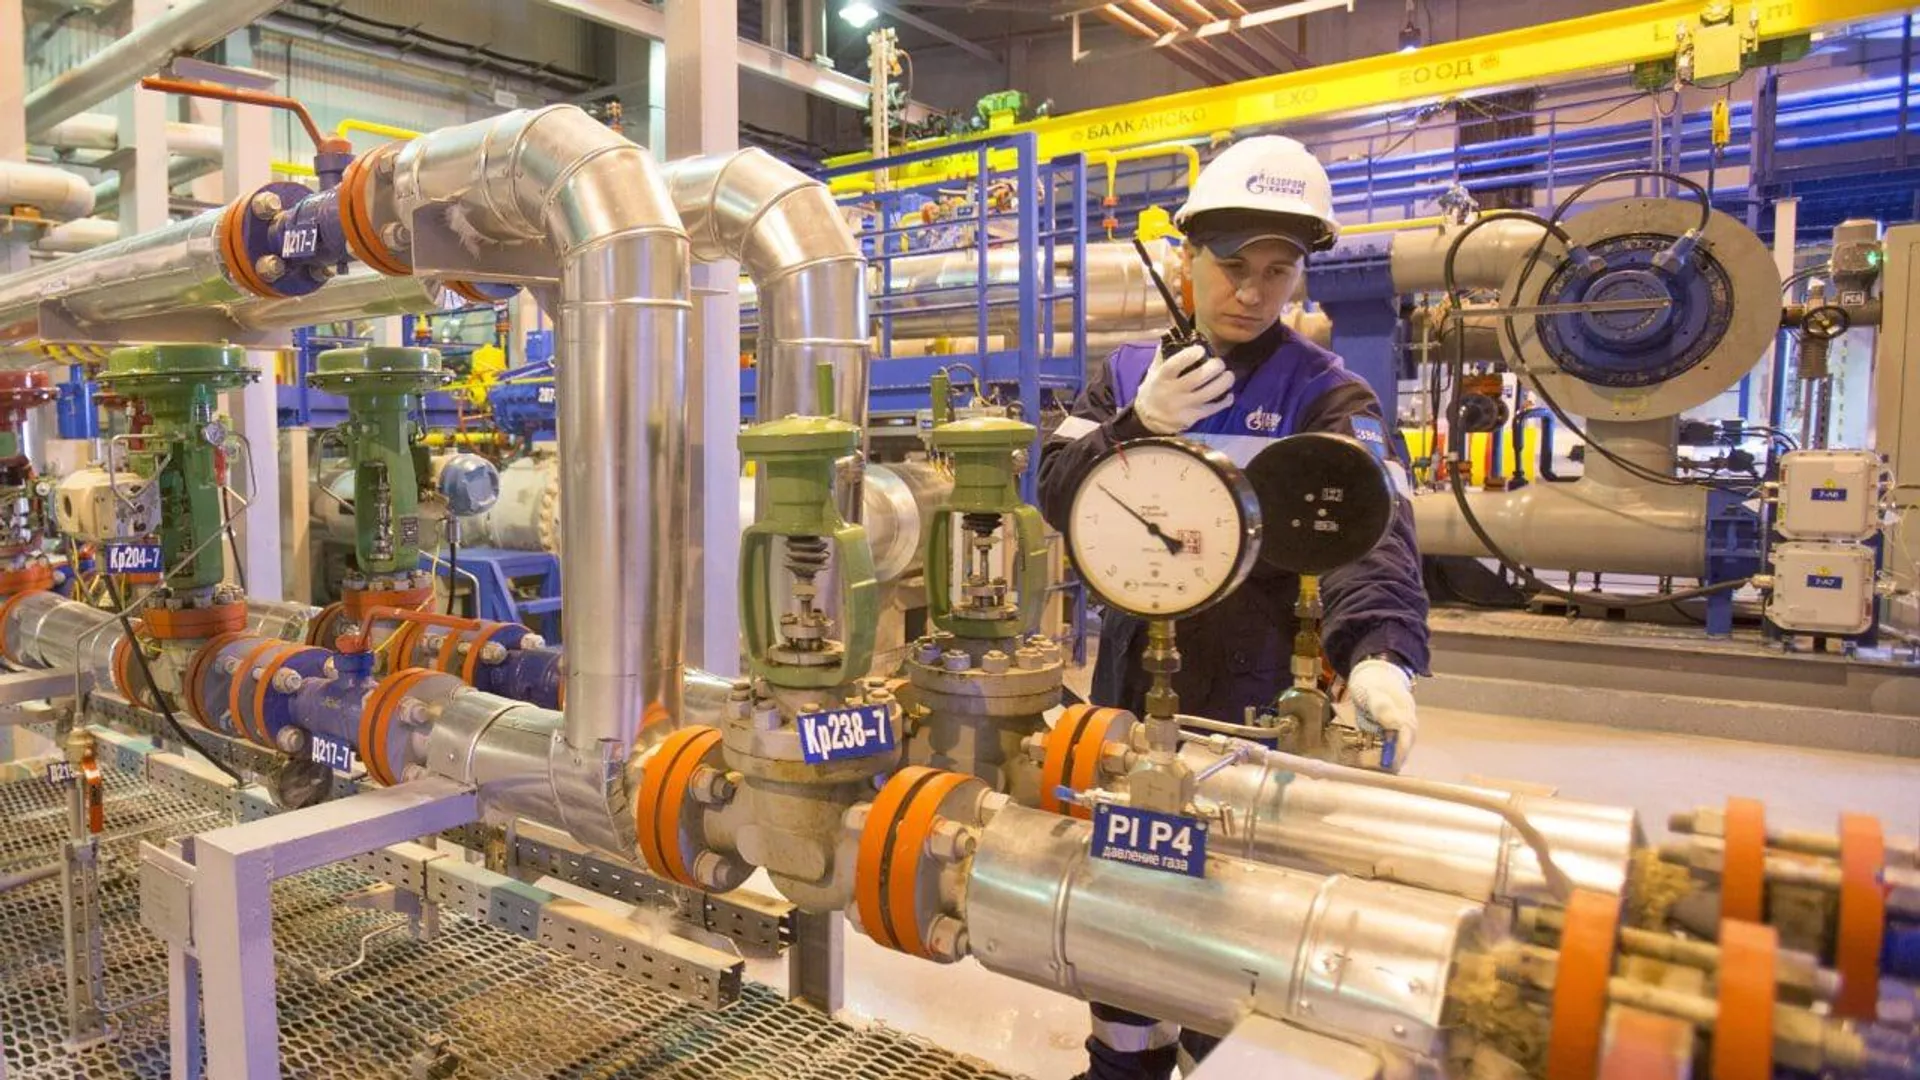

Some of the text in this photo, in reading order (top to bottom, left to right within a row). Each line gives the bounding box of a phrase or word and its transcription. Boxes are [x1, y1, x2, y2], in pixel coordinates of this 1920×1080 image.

[1087, 107, 1206, 140] БАЛКАНСКО
[282, 229, 317, 258] Д217-7
[110, 546, 160, 572] Кр204-7
[803, 710, 887, 760] Кр238-7
[312, 736, 350, 769] Д217-7
[1149, 821, 1192, 856] P4
[1102, 845, 1188, 871] давление газа
